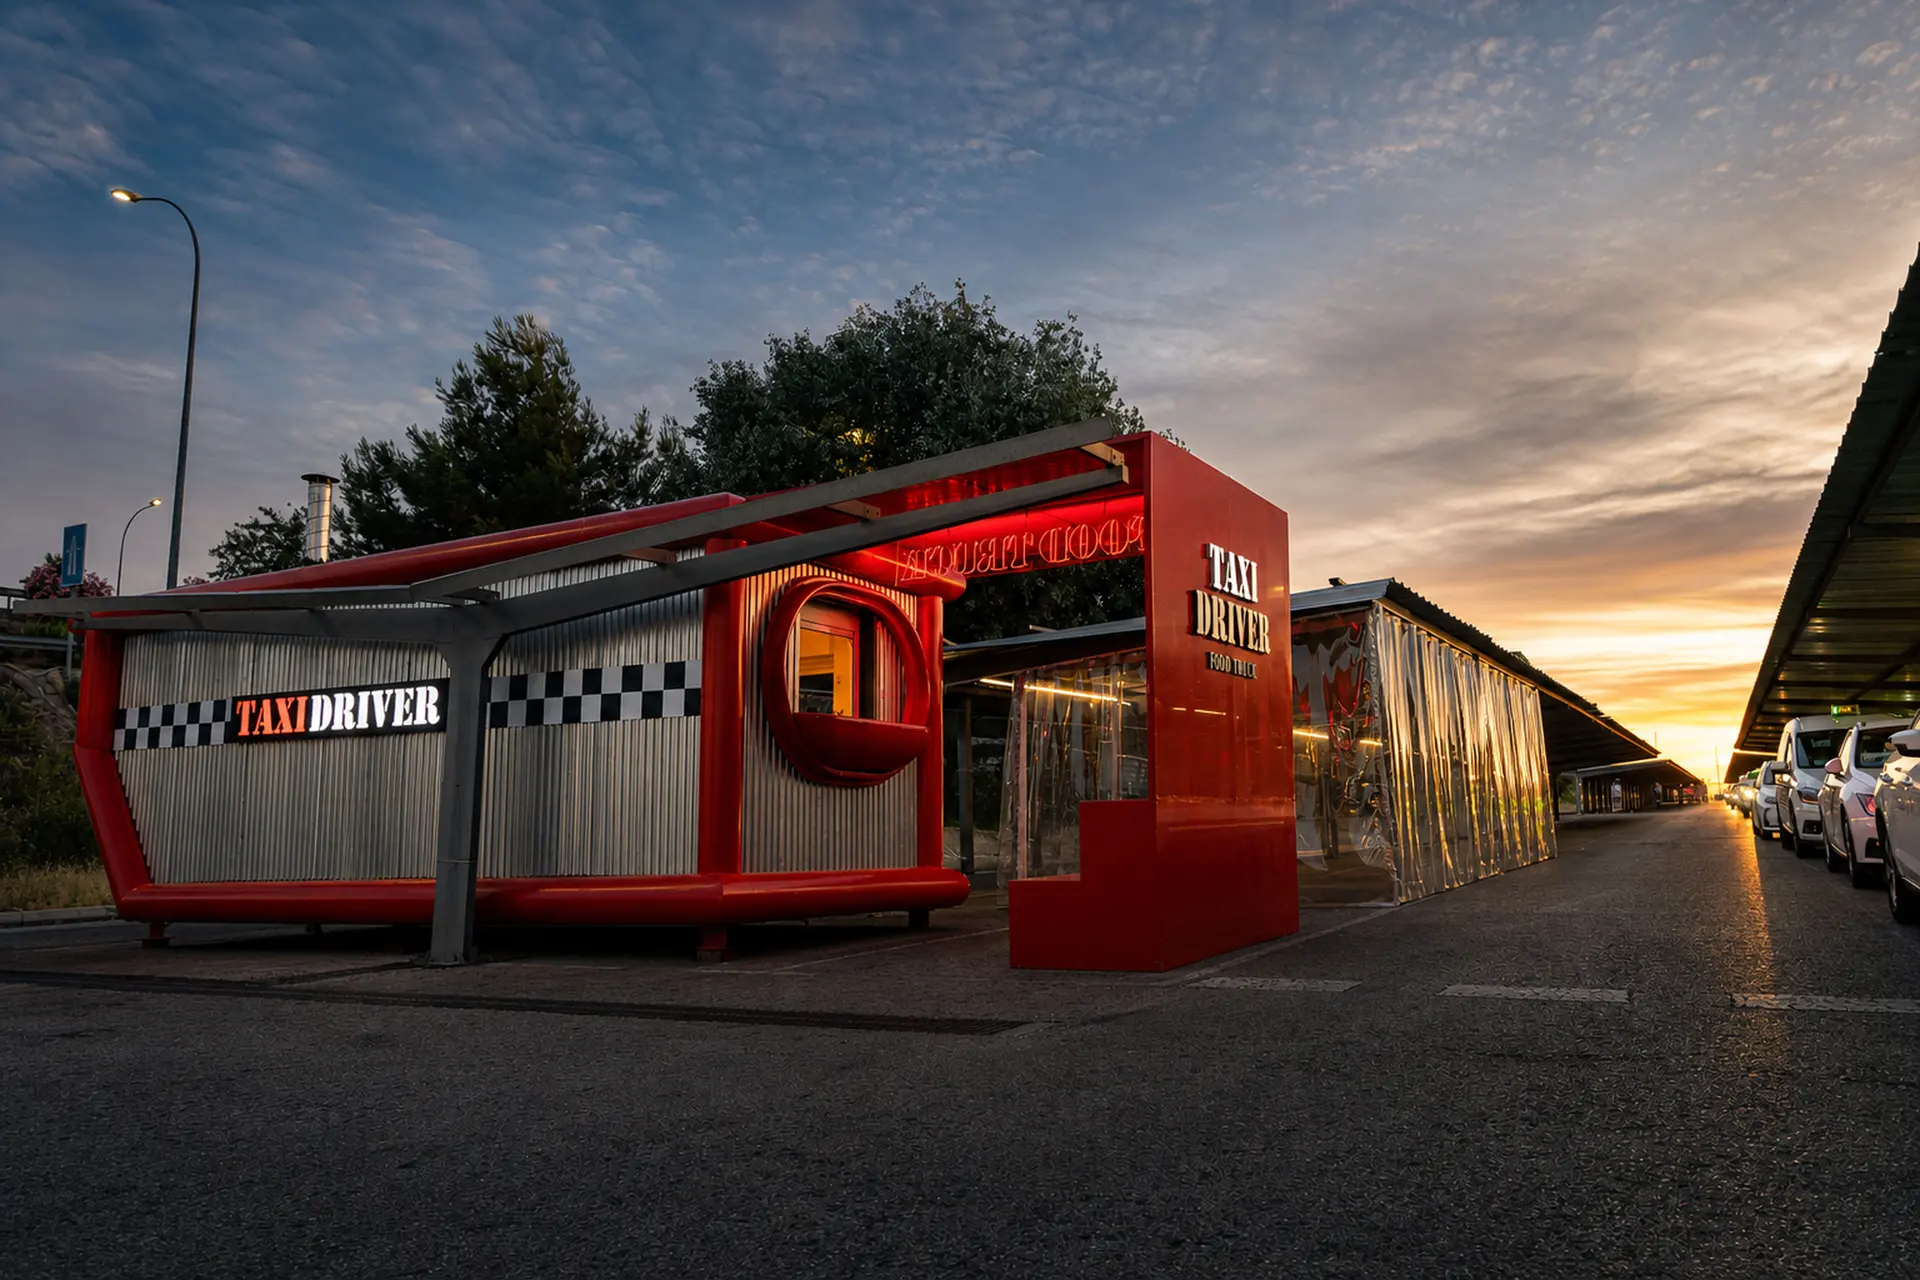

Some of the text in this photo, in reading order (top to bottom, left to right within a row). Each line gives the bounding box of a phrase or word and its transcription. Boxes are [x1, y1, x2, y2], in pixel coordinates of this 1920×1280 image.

[1208, 543, 1258, 603] TAXI
[1194, 589, 1271, 654] DRIVER
[1209, 651, 1231, 673] FOOD
